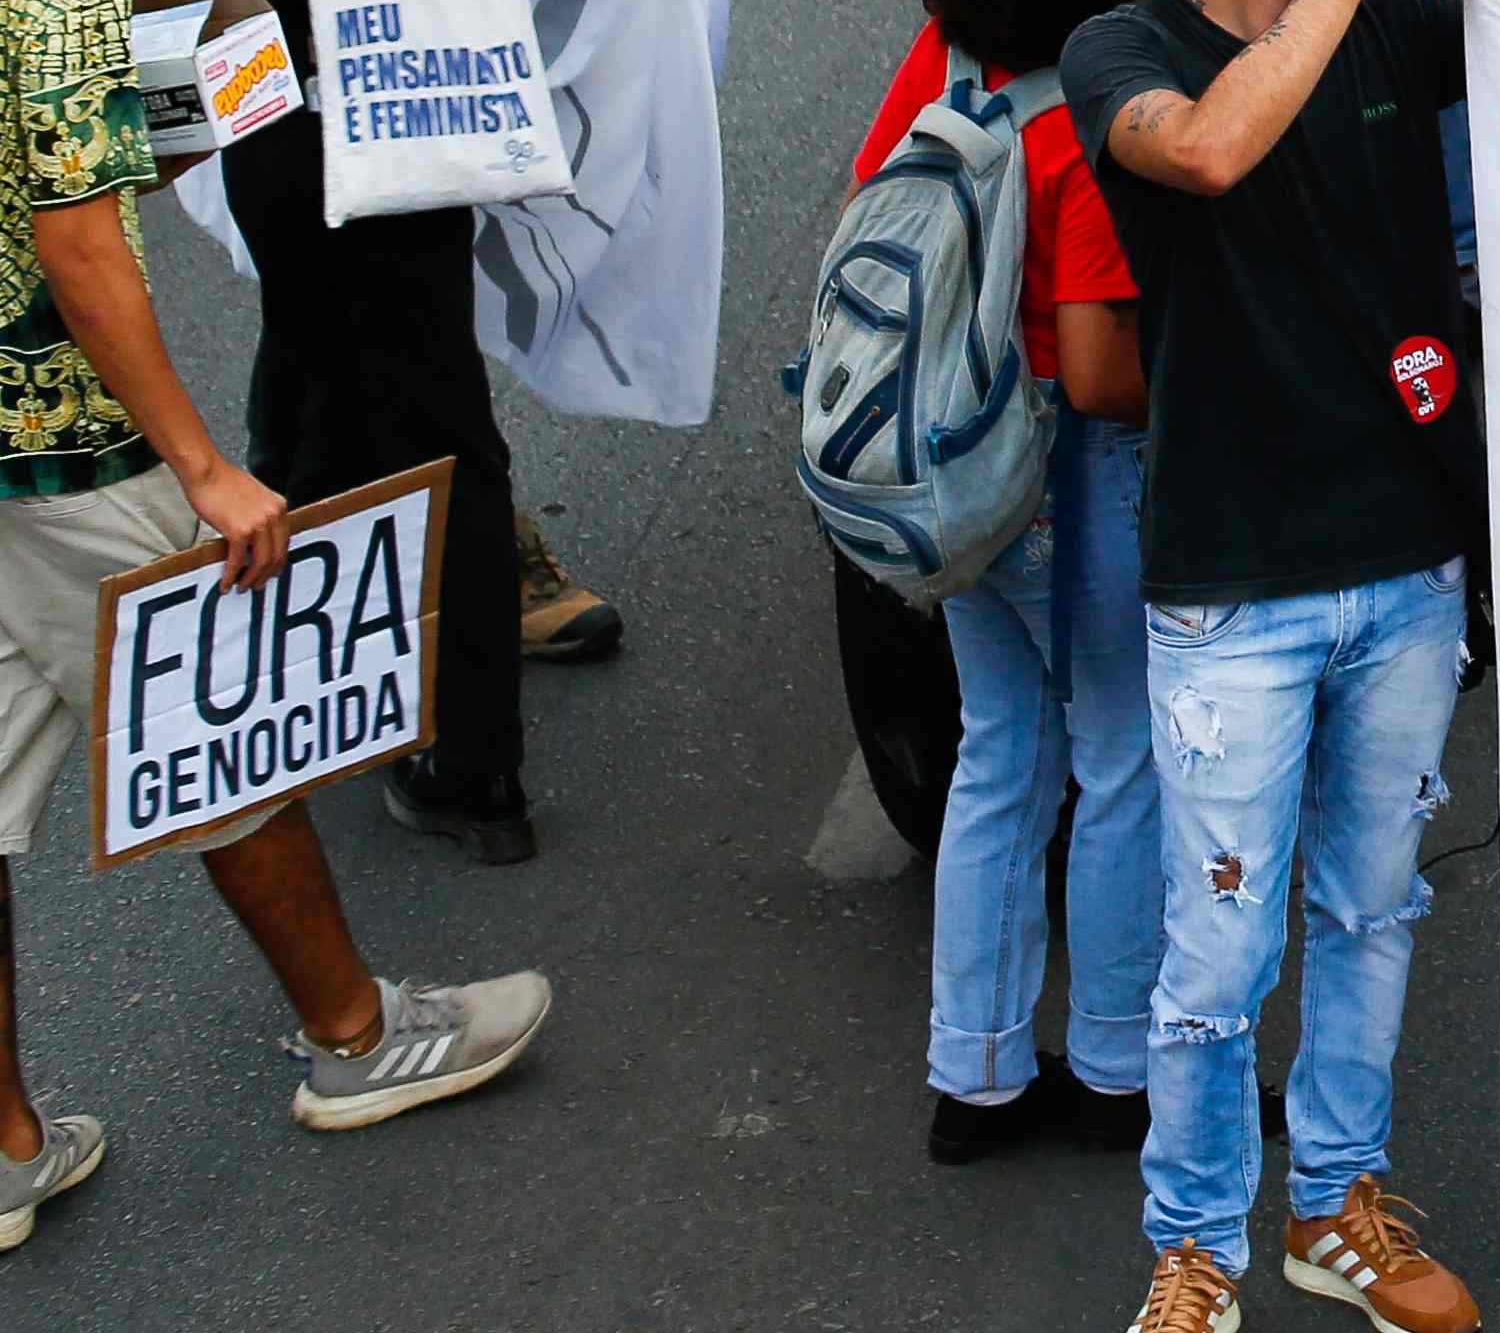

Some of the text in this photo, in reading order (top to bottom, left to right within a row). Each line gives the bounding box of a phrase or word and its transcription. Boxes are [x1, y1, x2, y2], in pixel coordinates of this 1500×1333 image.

[336, 2, 401, 50] MEU
[347, 91, 533, 144] É FEMINISTA
[1361, 100, 1398, 121] BOSS
[1392, 346, 1438, 373] FORA
[129, 513, 412, 755] FORA
[129, 670, 406, 831] GENOCIDA
